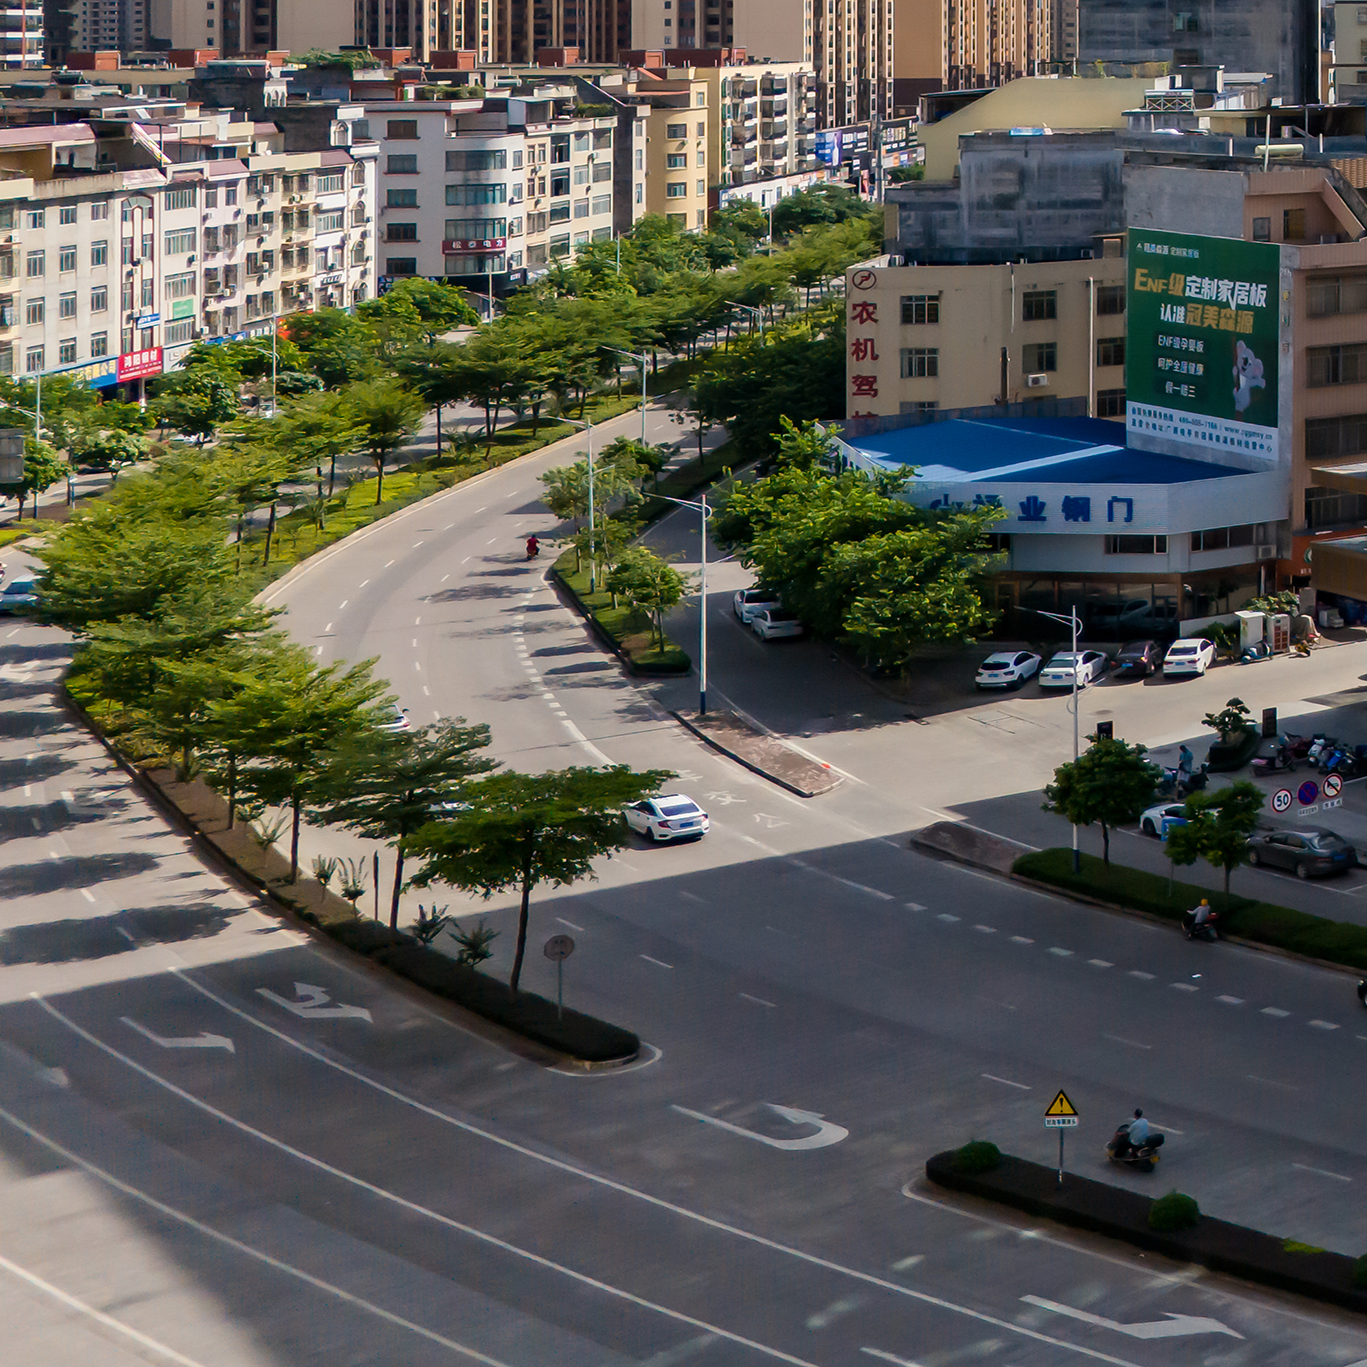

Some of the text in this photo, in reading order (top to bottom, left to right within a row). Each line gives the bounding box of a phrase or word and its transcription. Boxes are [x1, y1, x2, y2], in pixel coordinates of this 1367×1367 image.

[1160, 302, 1255, 334] 认准冠美森源
[1276, 793, 1289, 807] 50
